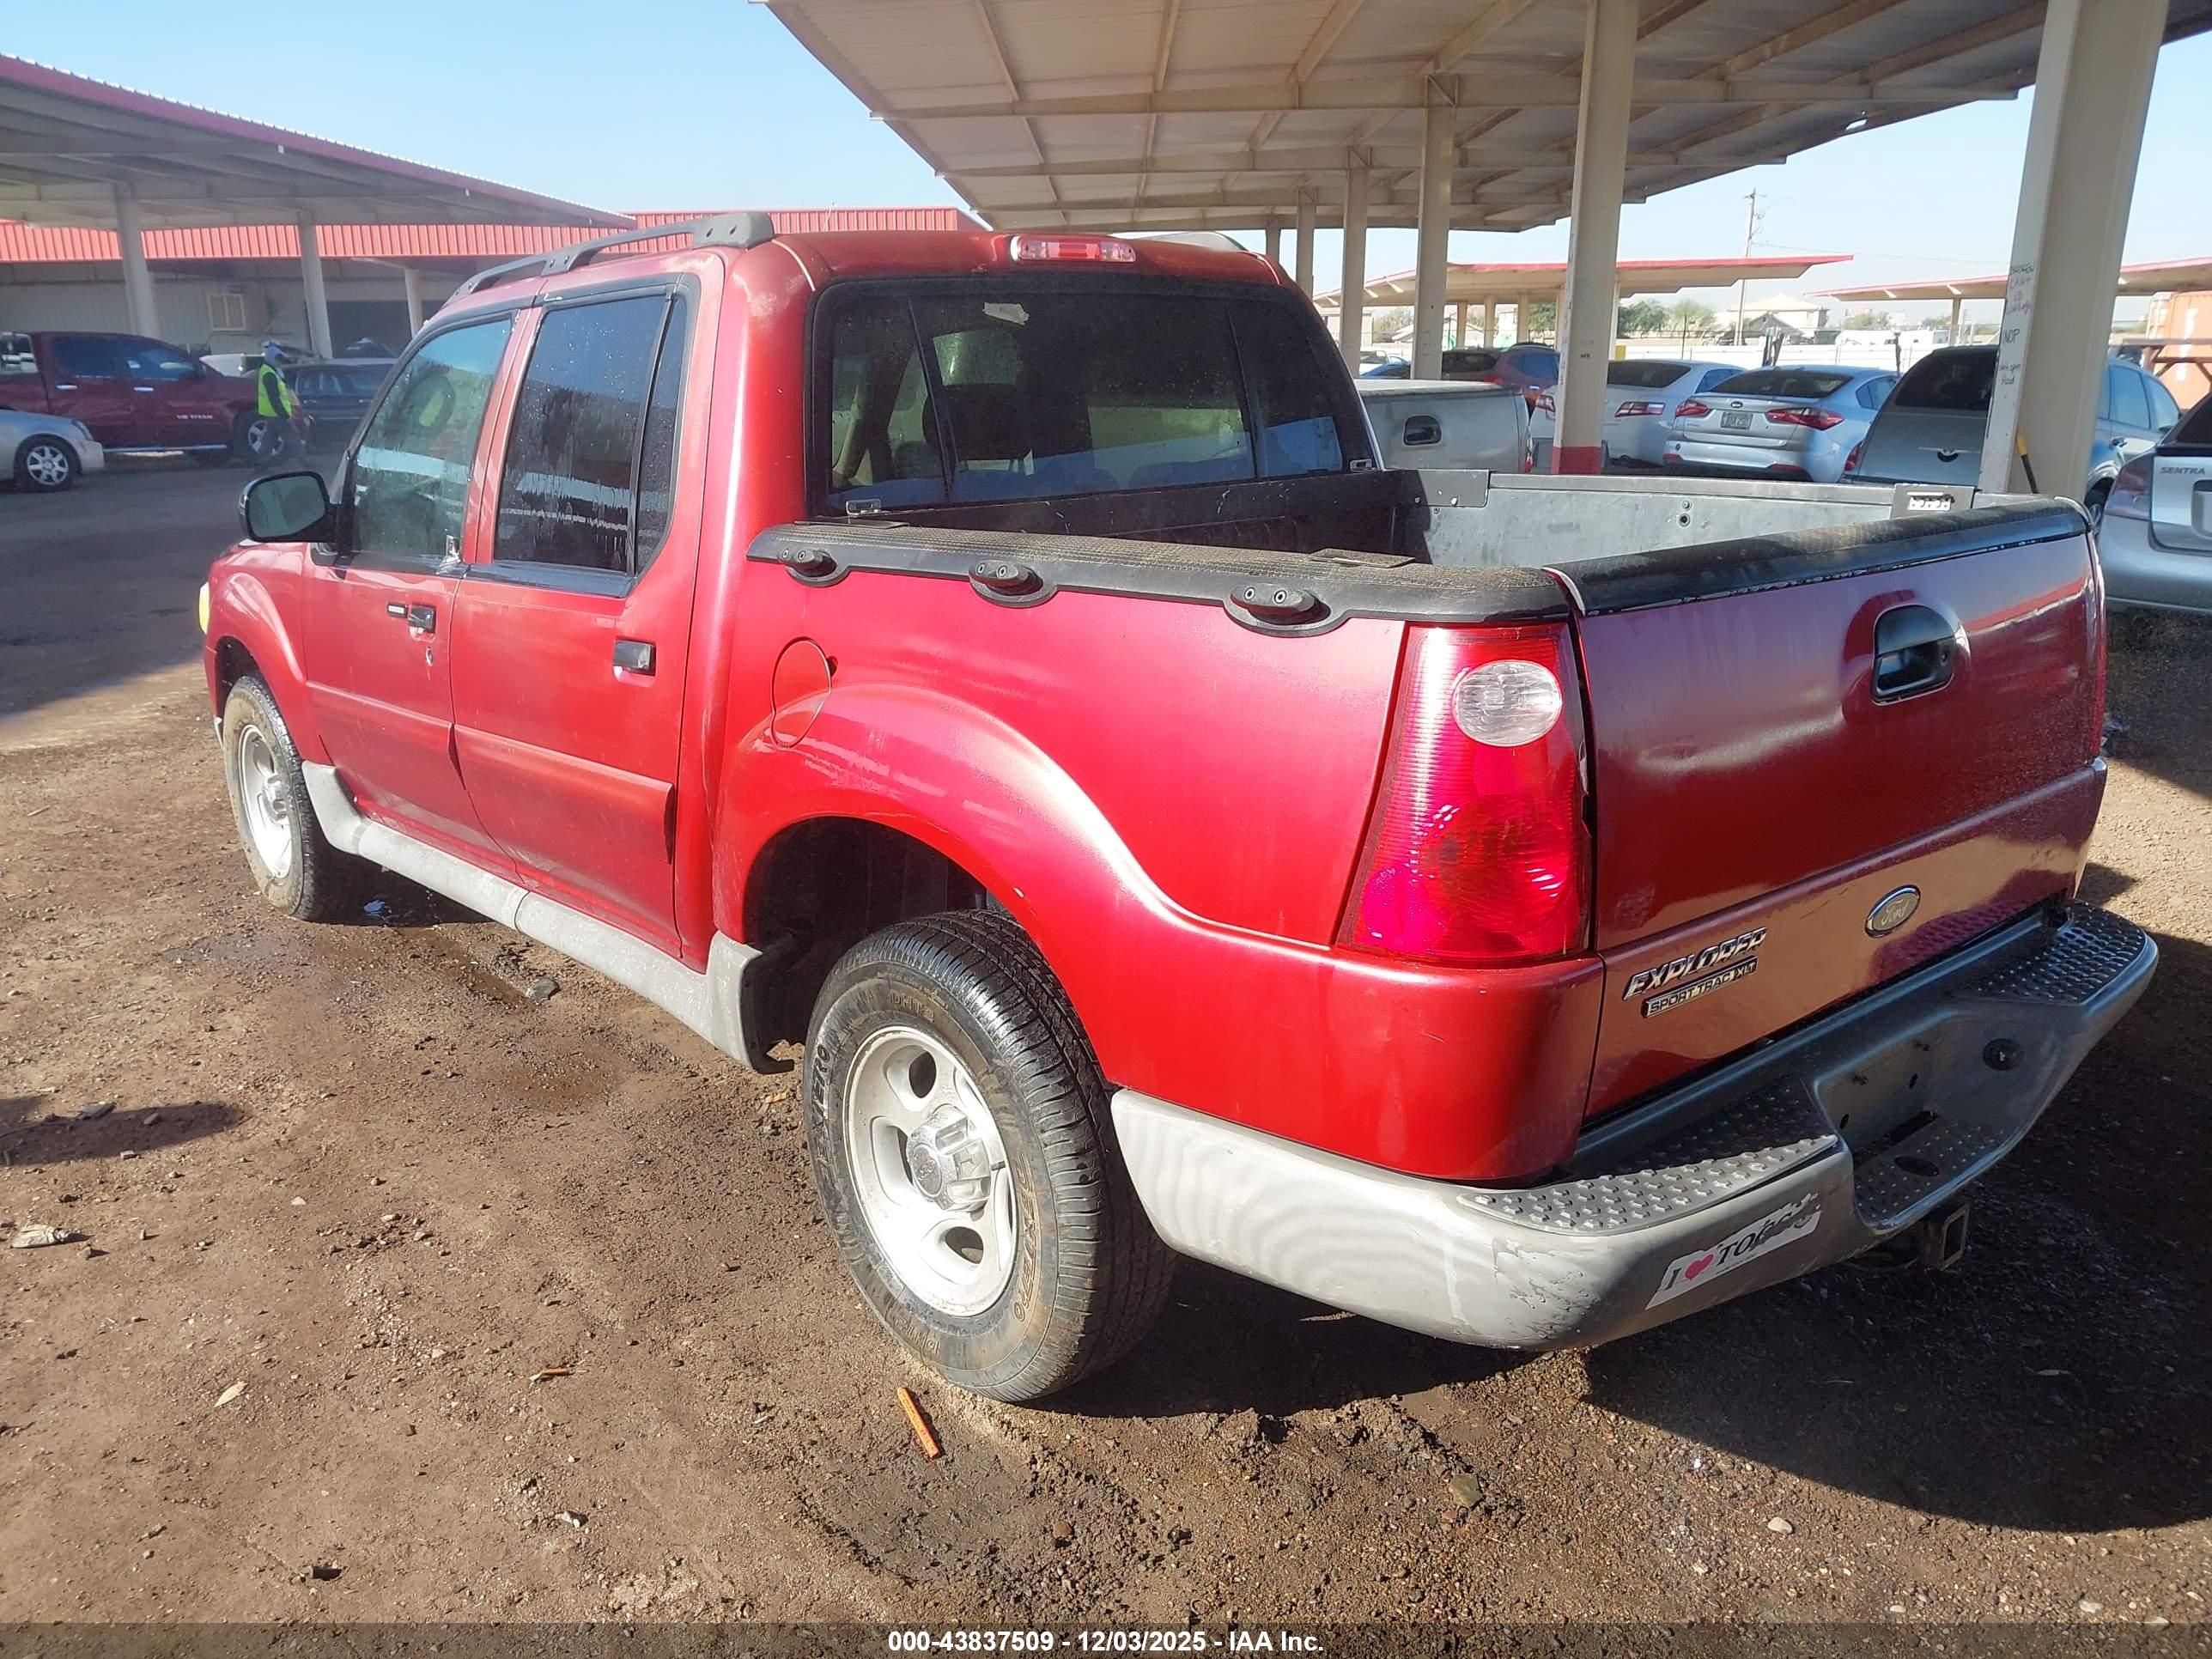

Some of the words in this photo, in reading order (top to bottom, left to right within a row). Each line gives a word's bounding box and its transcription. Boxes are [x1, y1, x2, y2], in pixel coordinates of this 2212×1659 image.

[2160, 466, 2206, 475] SENTRA
[1881, 898, 1910, 926] Ford
[1622, 927, 1768, 1001] EXPLORER
[1650, 988, 1695, 1016] SPORT
[1735, 959, 1758, 981] XLT
